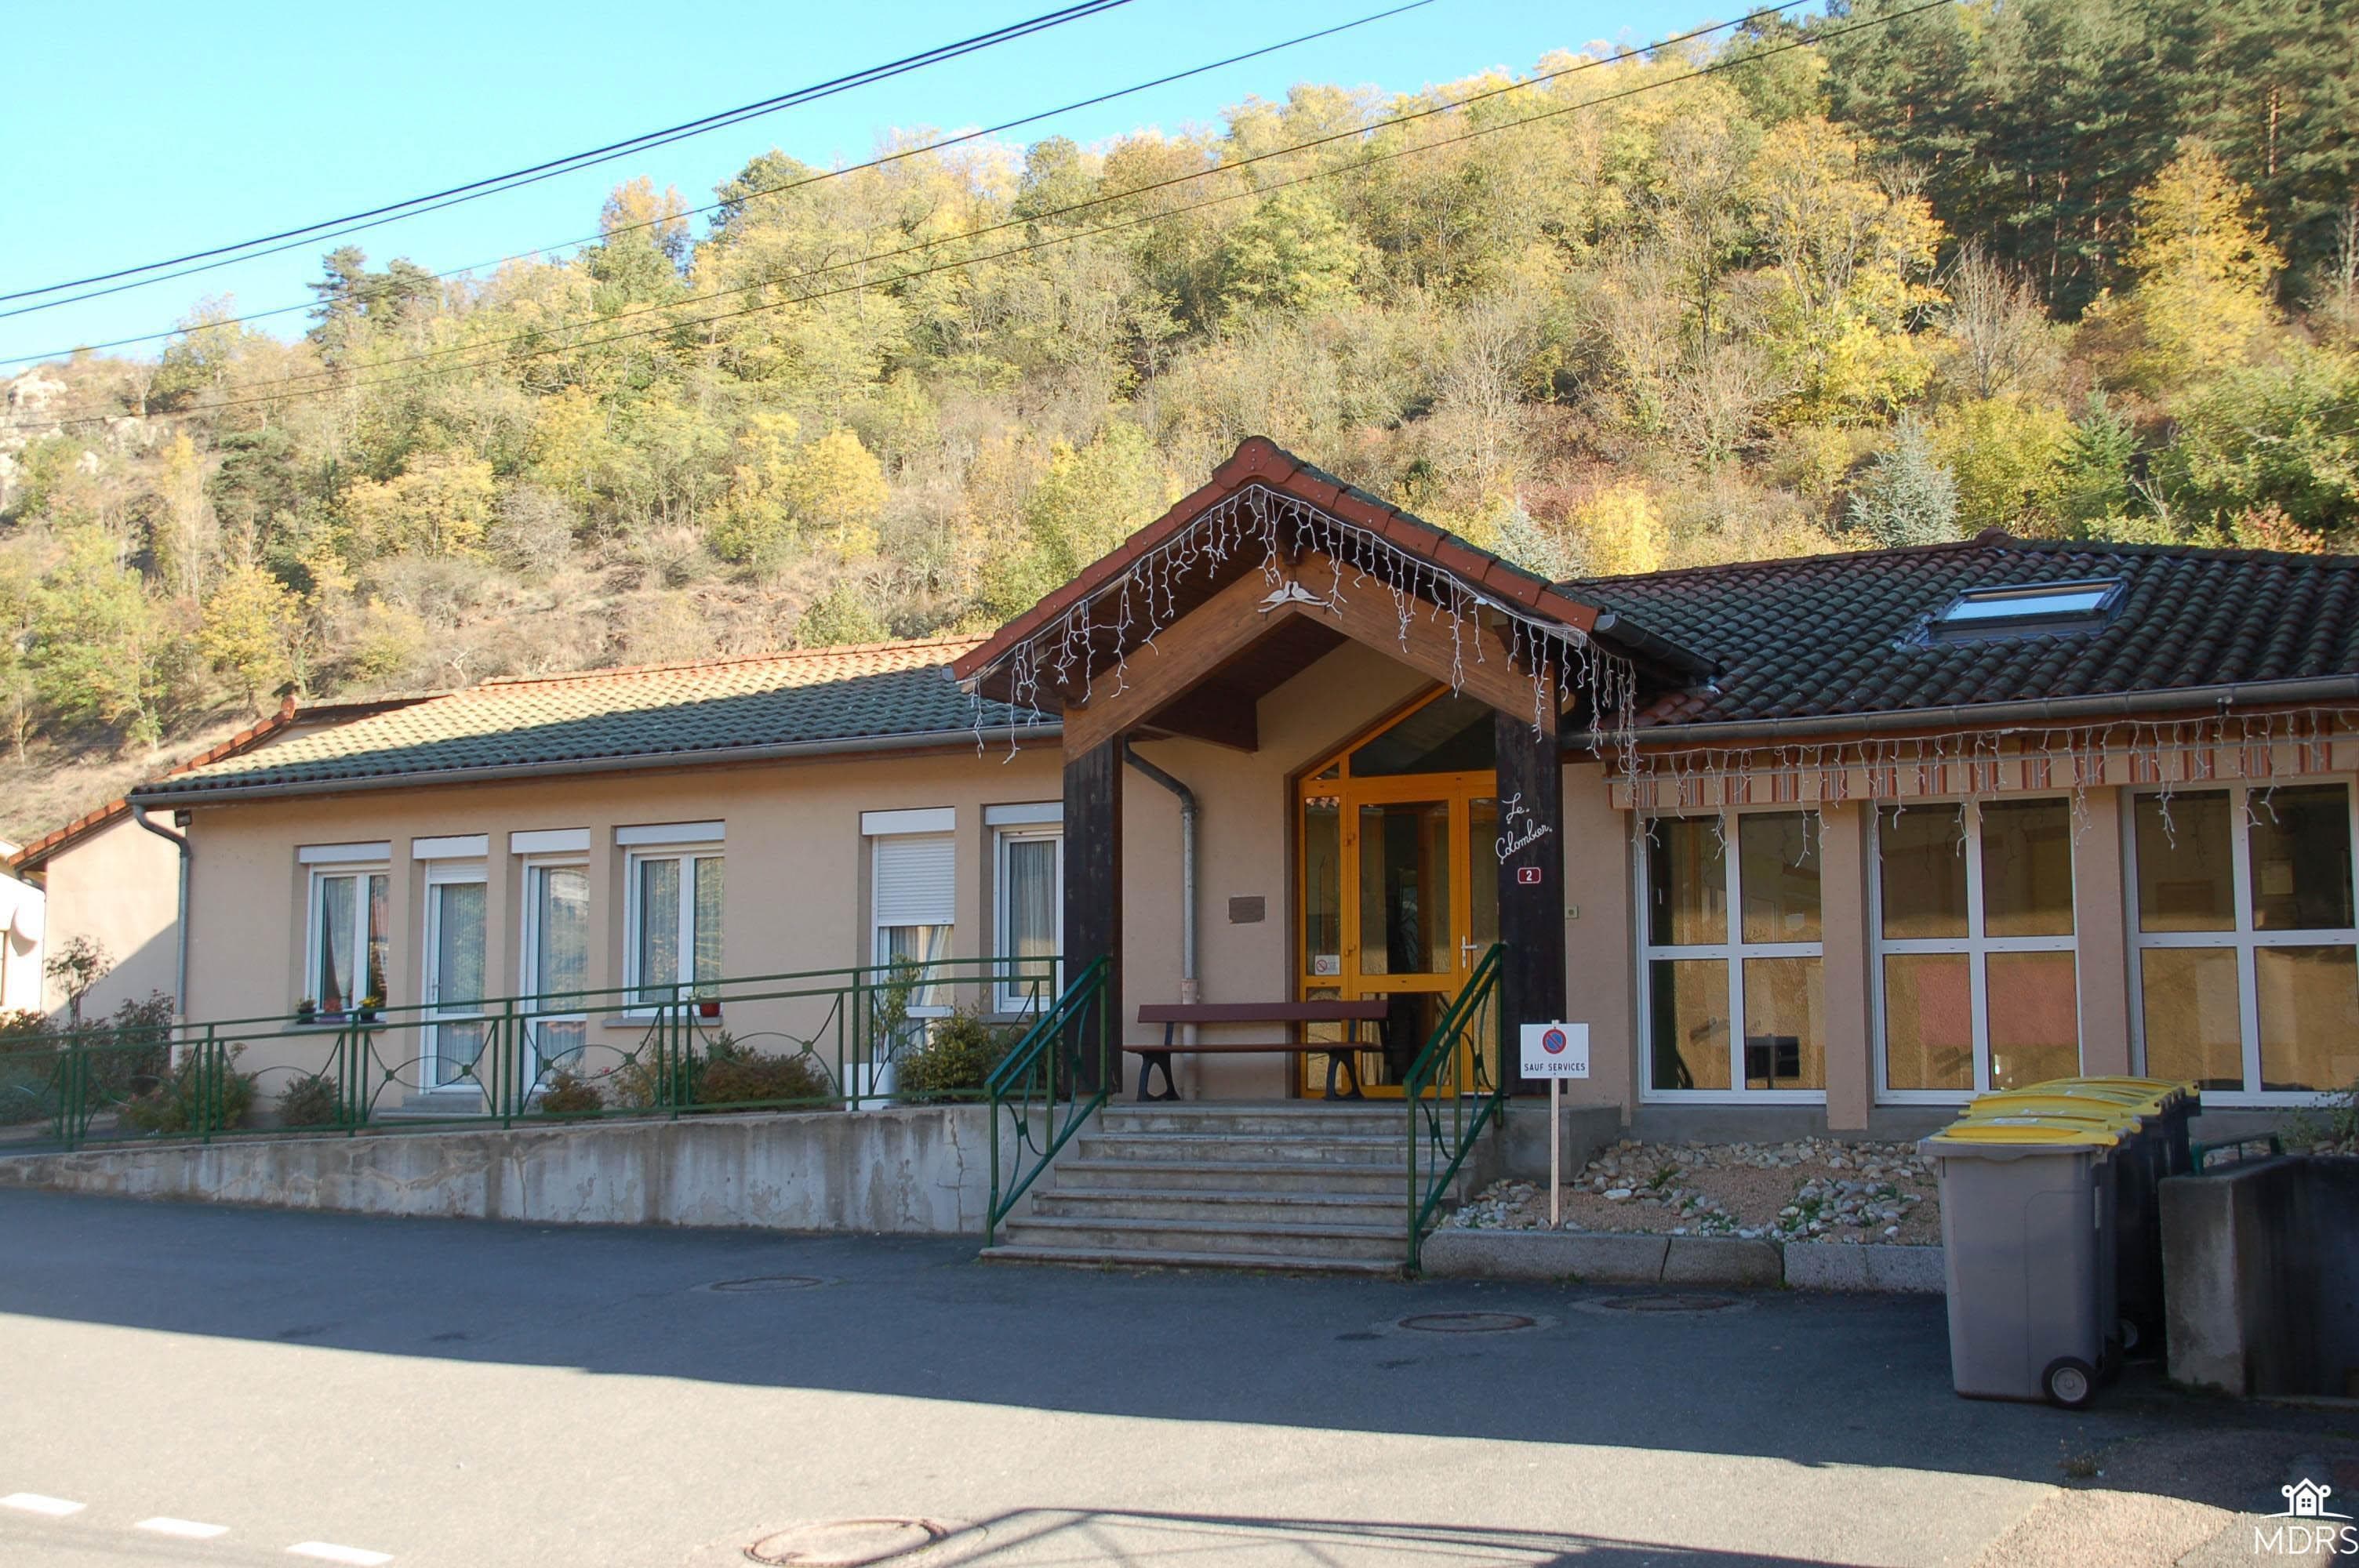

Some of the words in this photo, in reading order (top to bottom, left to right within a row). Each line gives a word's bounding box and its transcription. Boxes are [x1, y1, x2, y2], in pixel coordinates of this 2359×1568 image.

[1526, 870, 1532, 881] 2
[1524, 1062, 1544, 1072] SAUF
[1548, 1062, 1586, 1072] SERVICES
